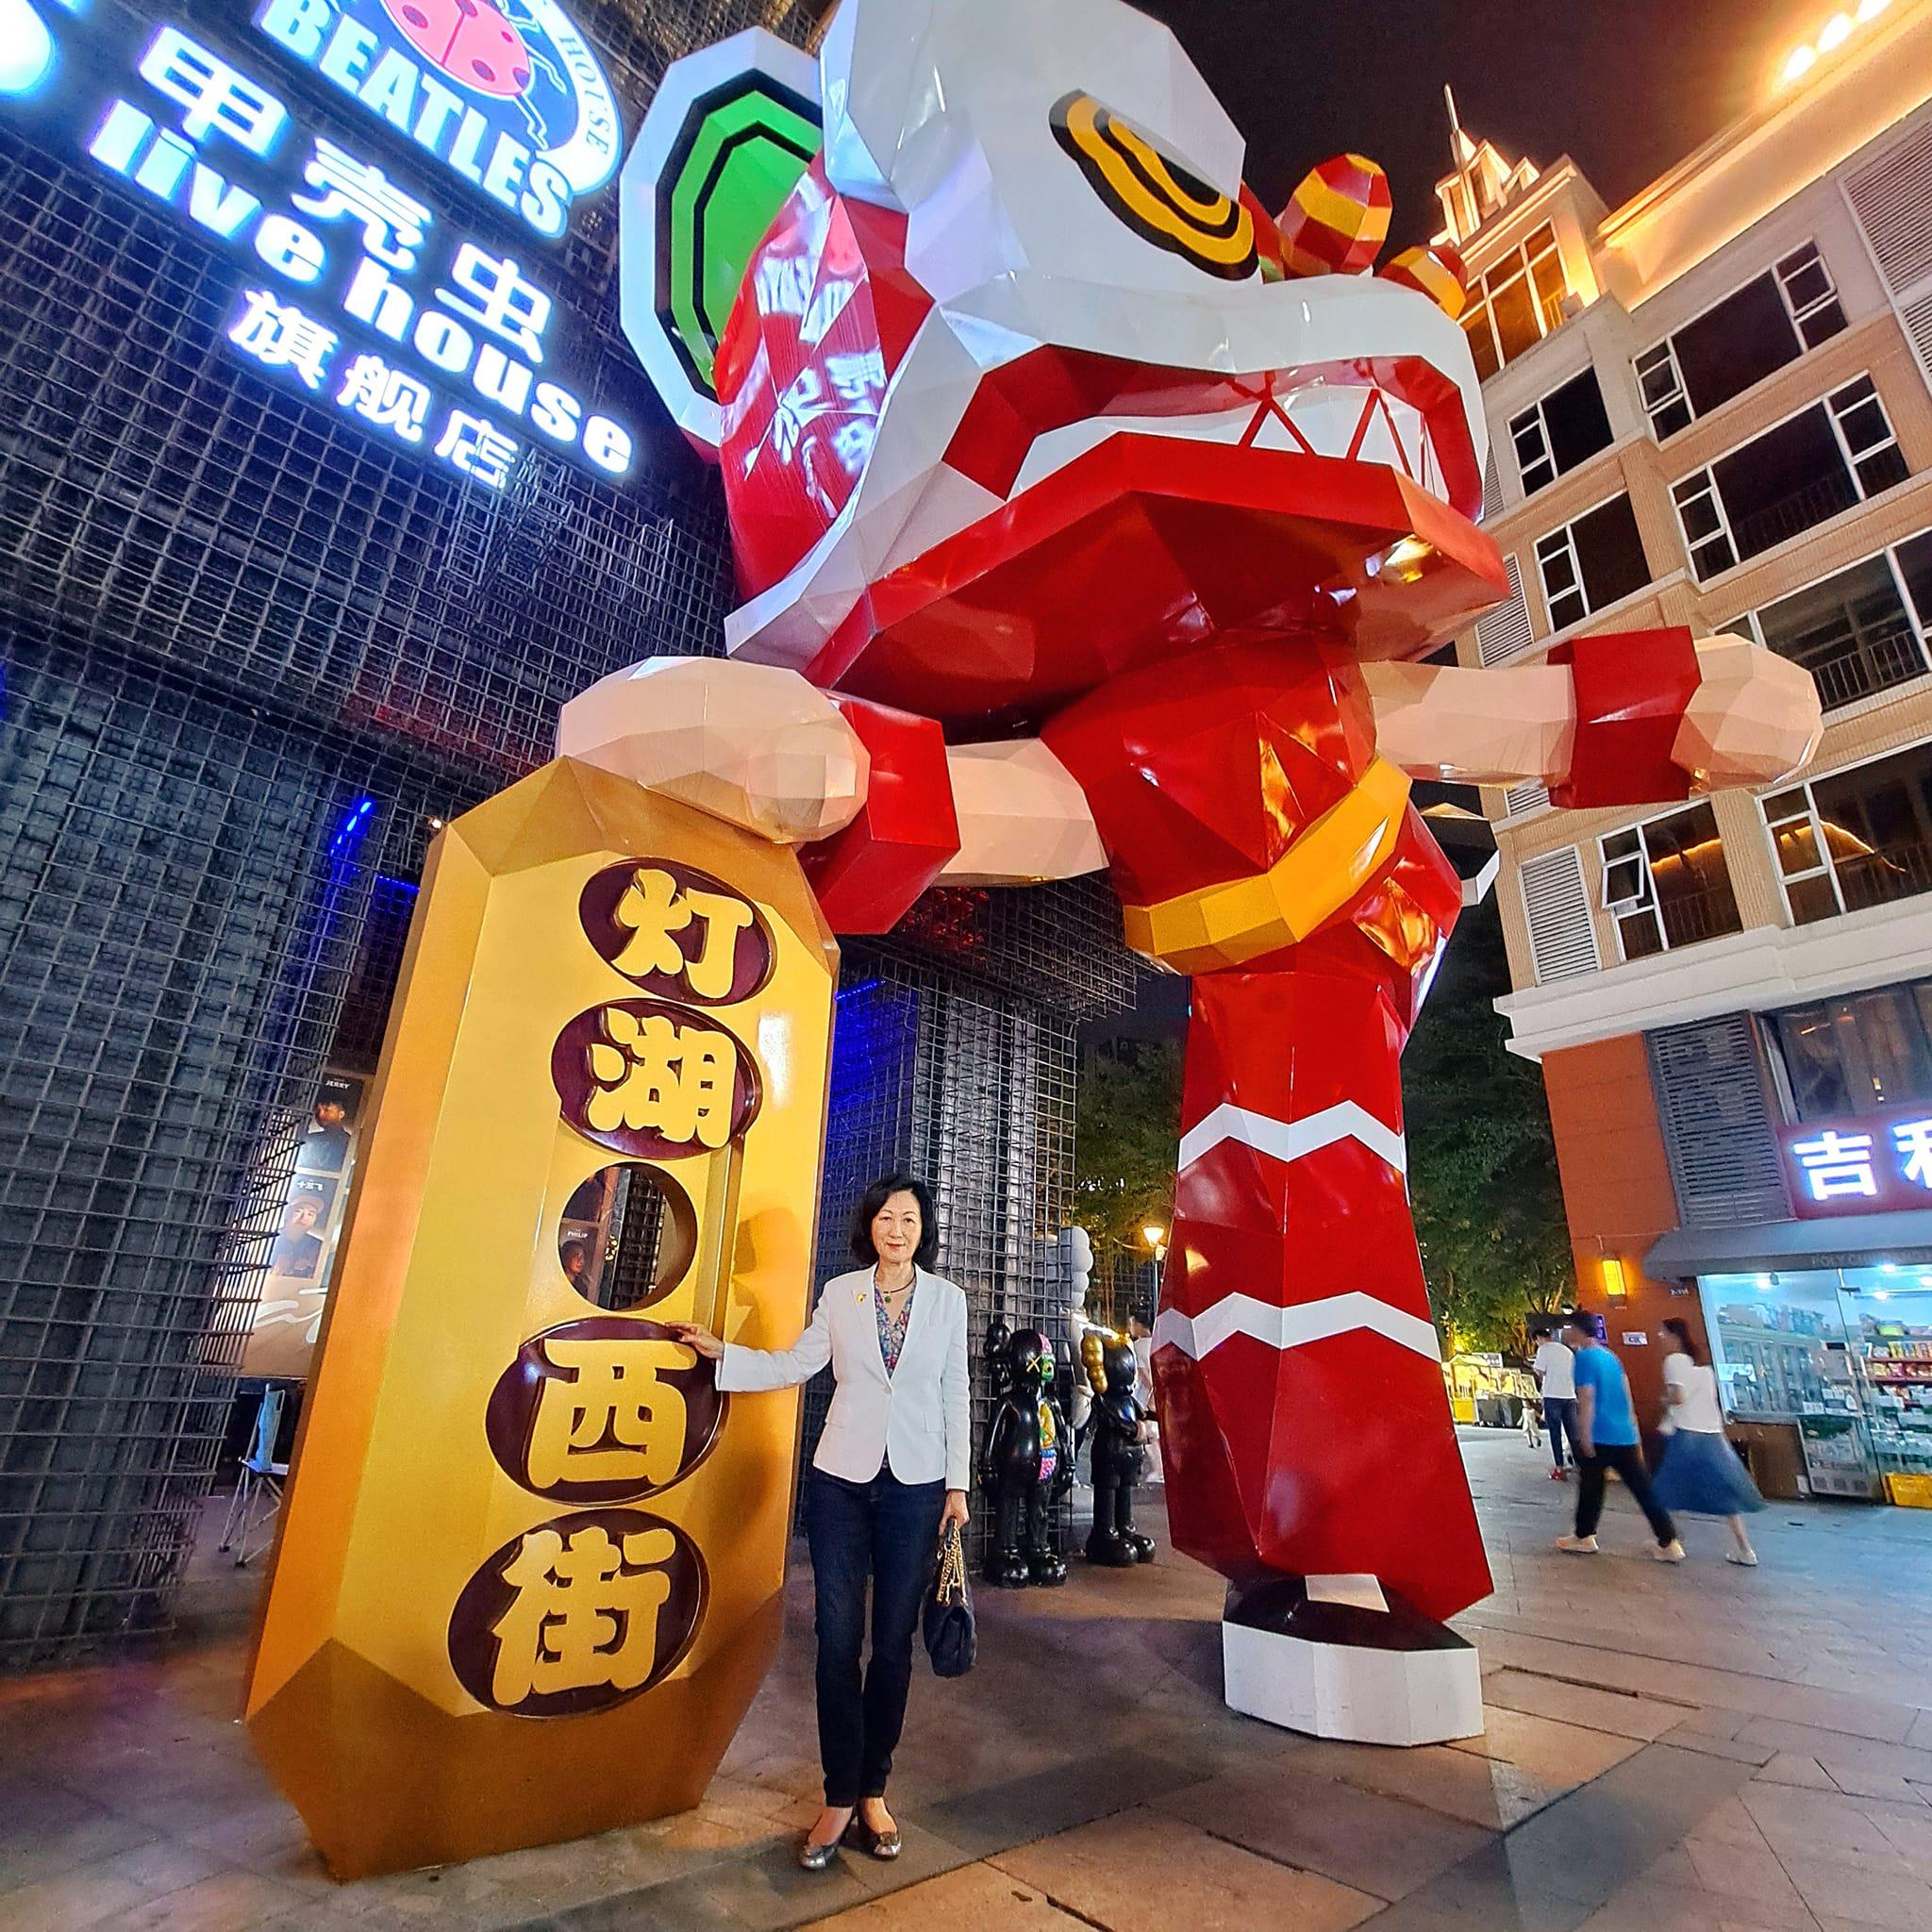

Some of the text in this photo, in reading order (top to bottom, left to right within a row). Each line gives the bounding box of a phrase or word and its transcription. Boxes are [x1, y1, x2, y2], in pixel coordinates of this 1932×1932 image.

[259, 0, 568, 237] BEATLES
[89, 99, 633, 474] live house
[227, 289, 519, 490] 旗舰店
